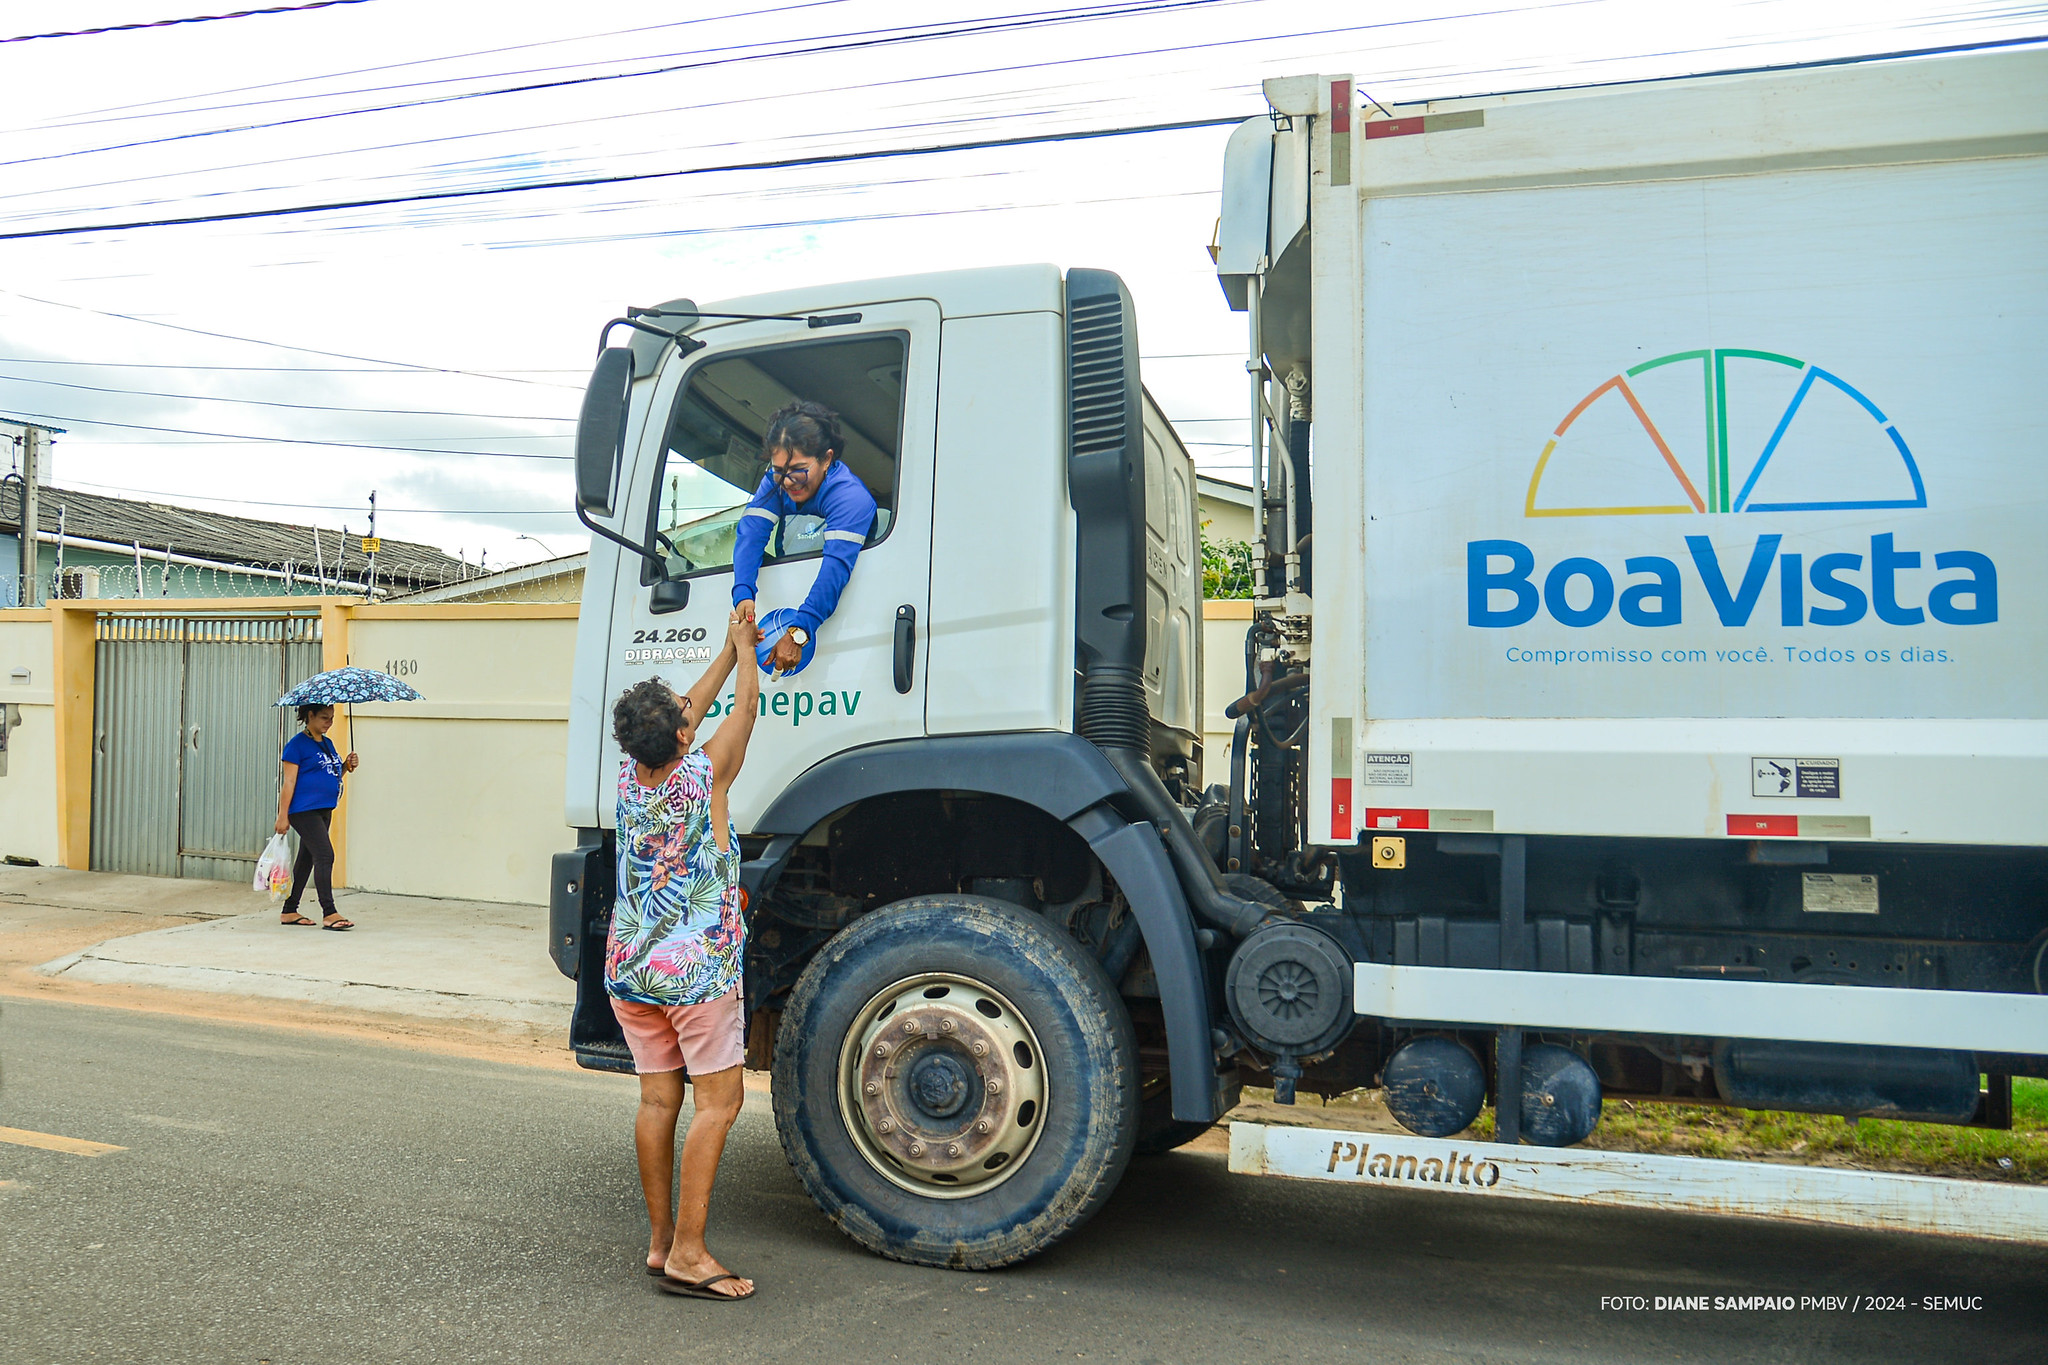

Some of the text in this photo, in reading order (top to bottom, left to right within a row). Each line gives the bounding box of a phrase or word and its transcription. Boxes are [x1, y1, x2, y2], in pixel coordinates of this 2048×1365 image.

[633, 627, 707, 644] 24.260
[625, 646, 711, 661] DIBRACAM
[1506, 646, 1955, 665] Compromisso com você. Todos os dias.
[385, 659, 418, 676] 1180
[1367, 755, 1409, 764] ATENÇÃO
[1327, 1141, 1500, 1187] Planalto
